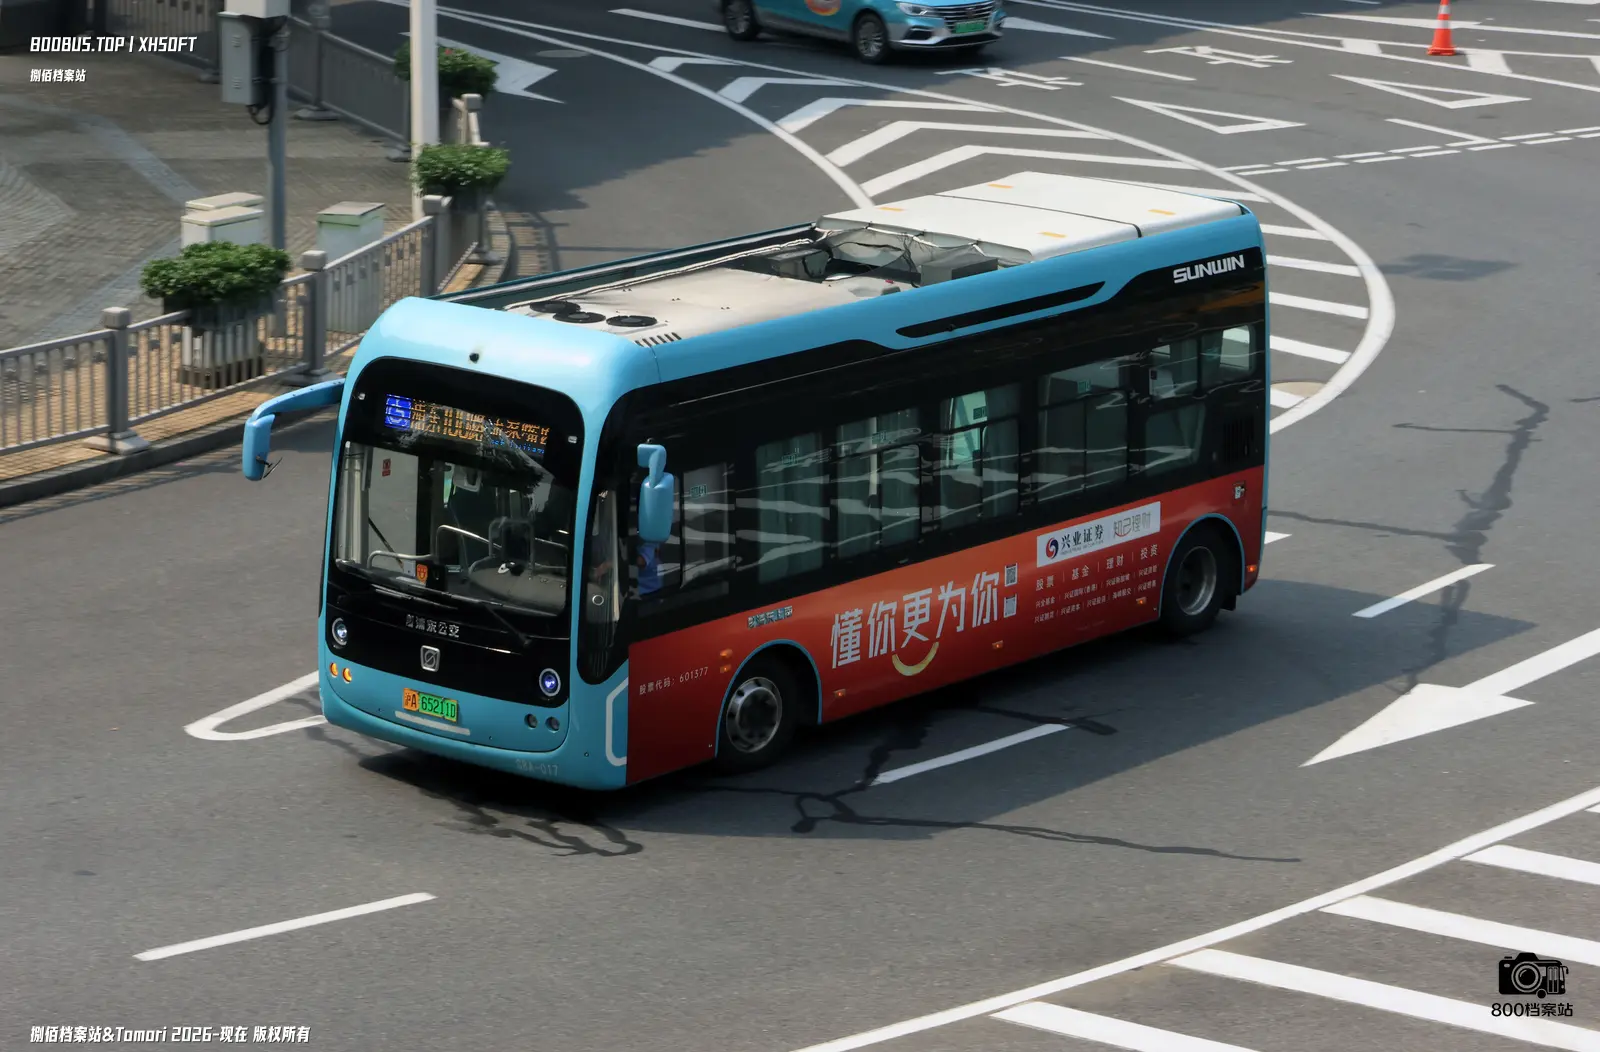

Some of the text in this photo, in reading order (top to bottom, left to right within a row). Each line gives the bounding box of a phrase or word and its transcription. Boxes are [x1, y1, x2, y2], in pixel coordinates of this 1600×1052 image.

[1173, 254, 1245, 284] SUNWIN
[1061, 511, 1151, 550] 兴业证券 知己理财
[1106, 553, 1125, 570] 理财
[1140, 543, 1158, 561] 投资
[830, 571, 1000, 669] 懂你更为你
